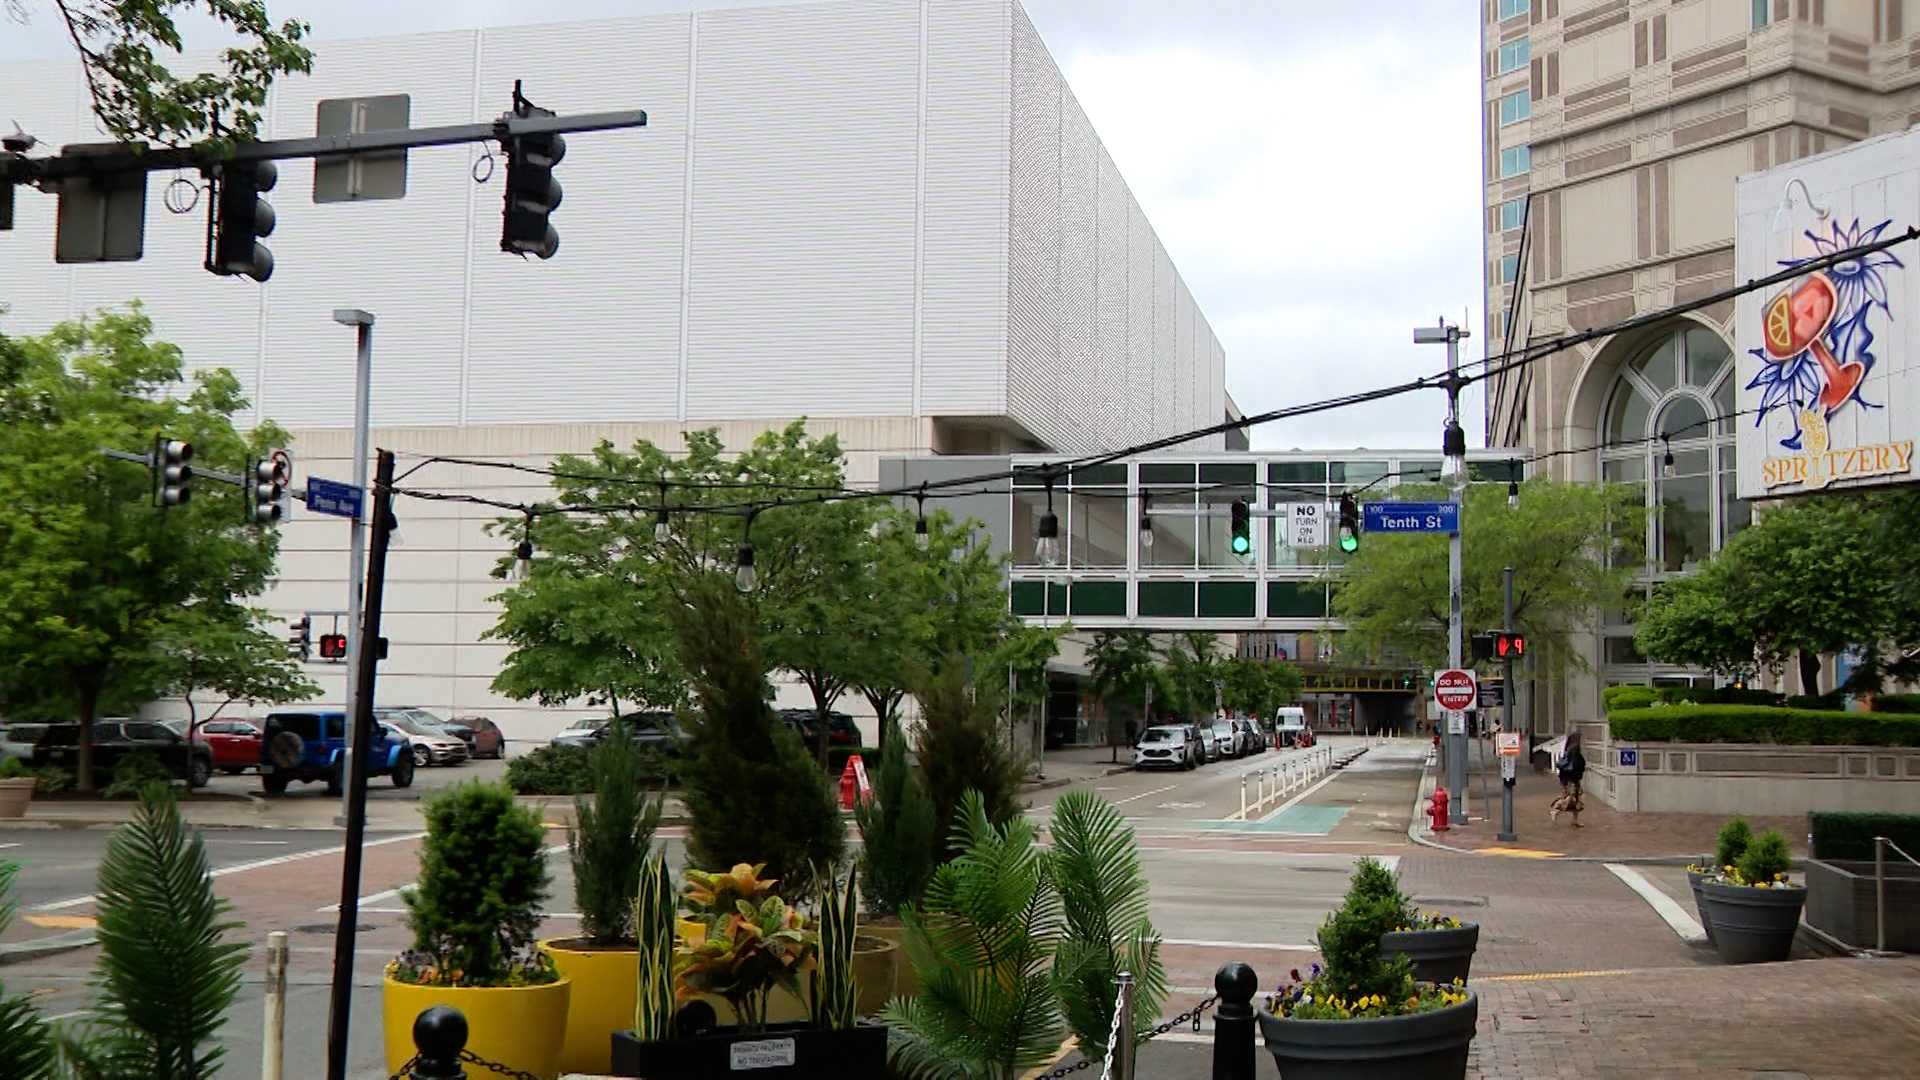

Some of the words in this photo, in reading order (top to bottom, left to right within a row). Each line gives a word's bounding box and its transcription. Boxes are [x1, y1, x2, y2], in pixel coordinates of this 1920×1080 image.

[1763, 440, 1913, 485] SPRITZERY
[1296, 505, 1316, 516] NO
[1296, 517, 1318, 526] TURN
[1381, 516, 1420, 528] Tenth
[1426, 515, 1442, 528] St
[1299, 527, 1313, 535] ON
[1442, 695, 1469, 703] ENTER
